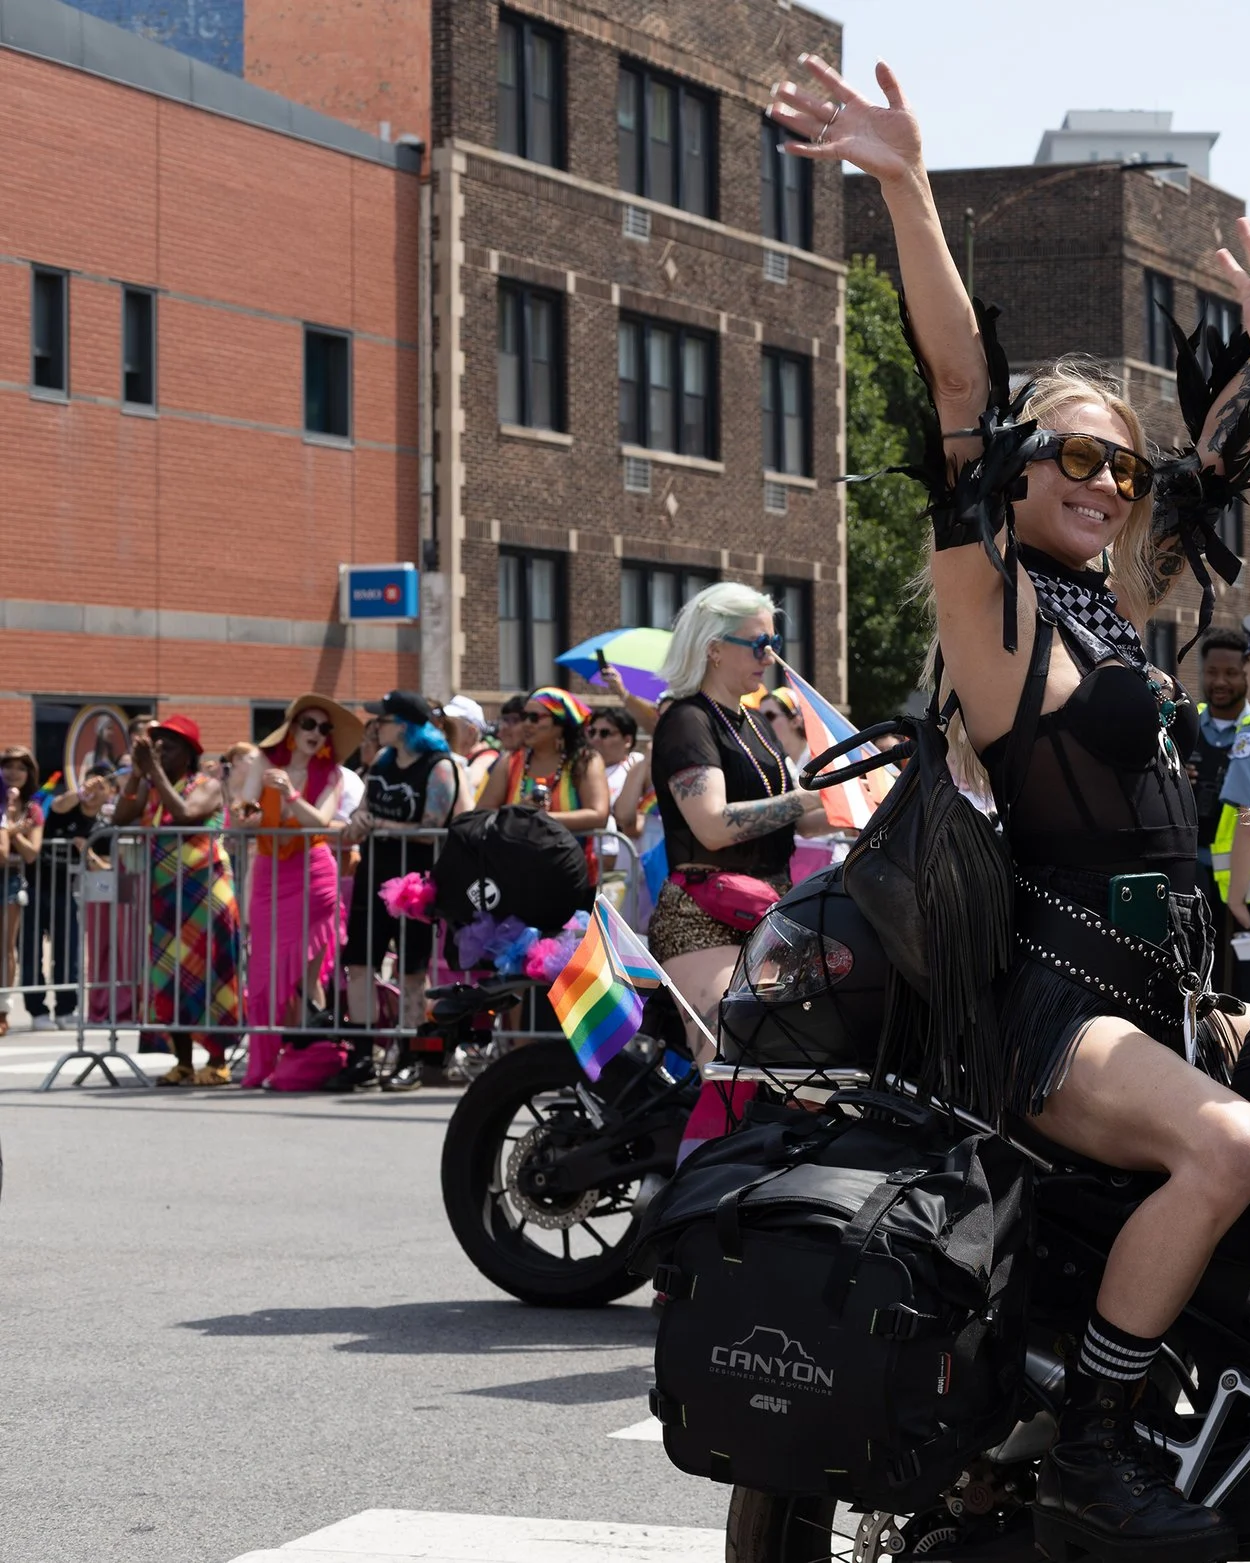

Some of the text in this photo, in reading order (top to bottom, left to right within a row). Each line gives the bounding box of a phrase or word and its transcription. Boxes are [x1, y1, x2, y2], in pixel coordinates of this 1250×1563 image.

[709, 1366, 833, 1397] DESIGNED FOR ADVENTURE
[711, 1345, 834, 1388] CANYON
